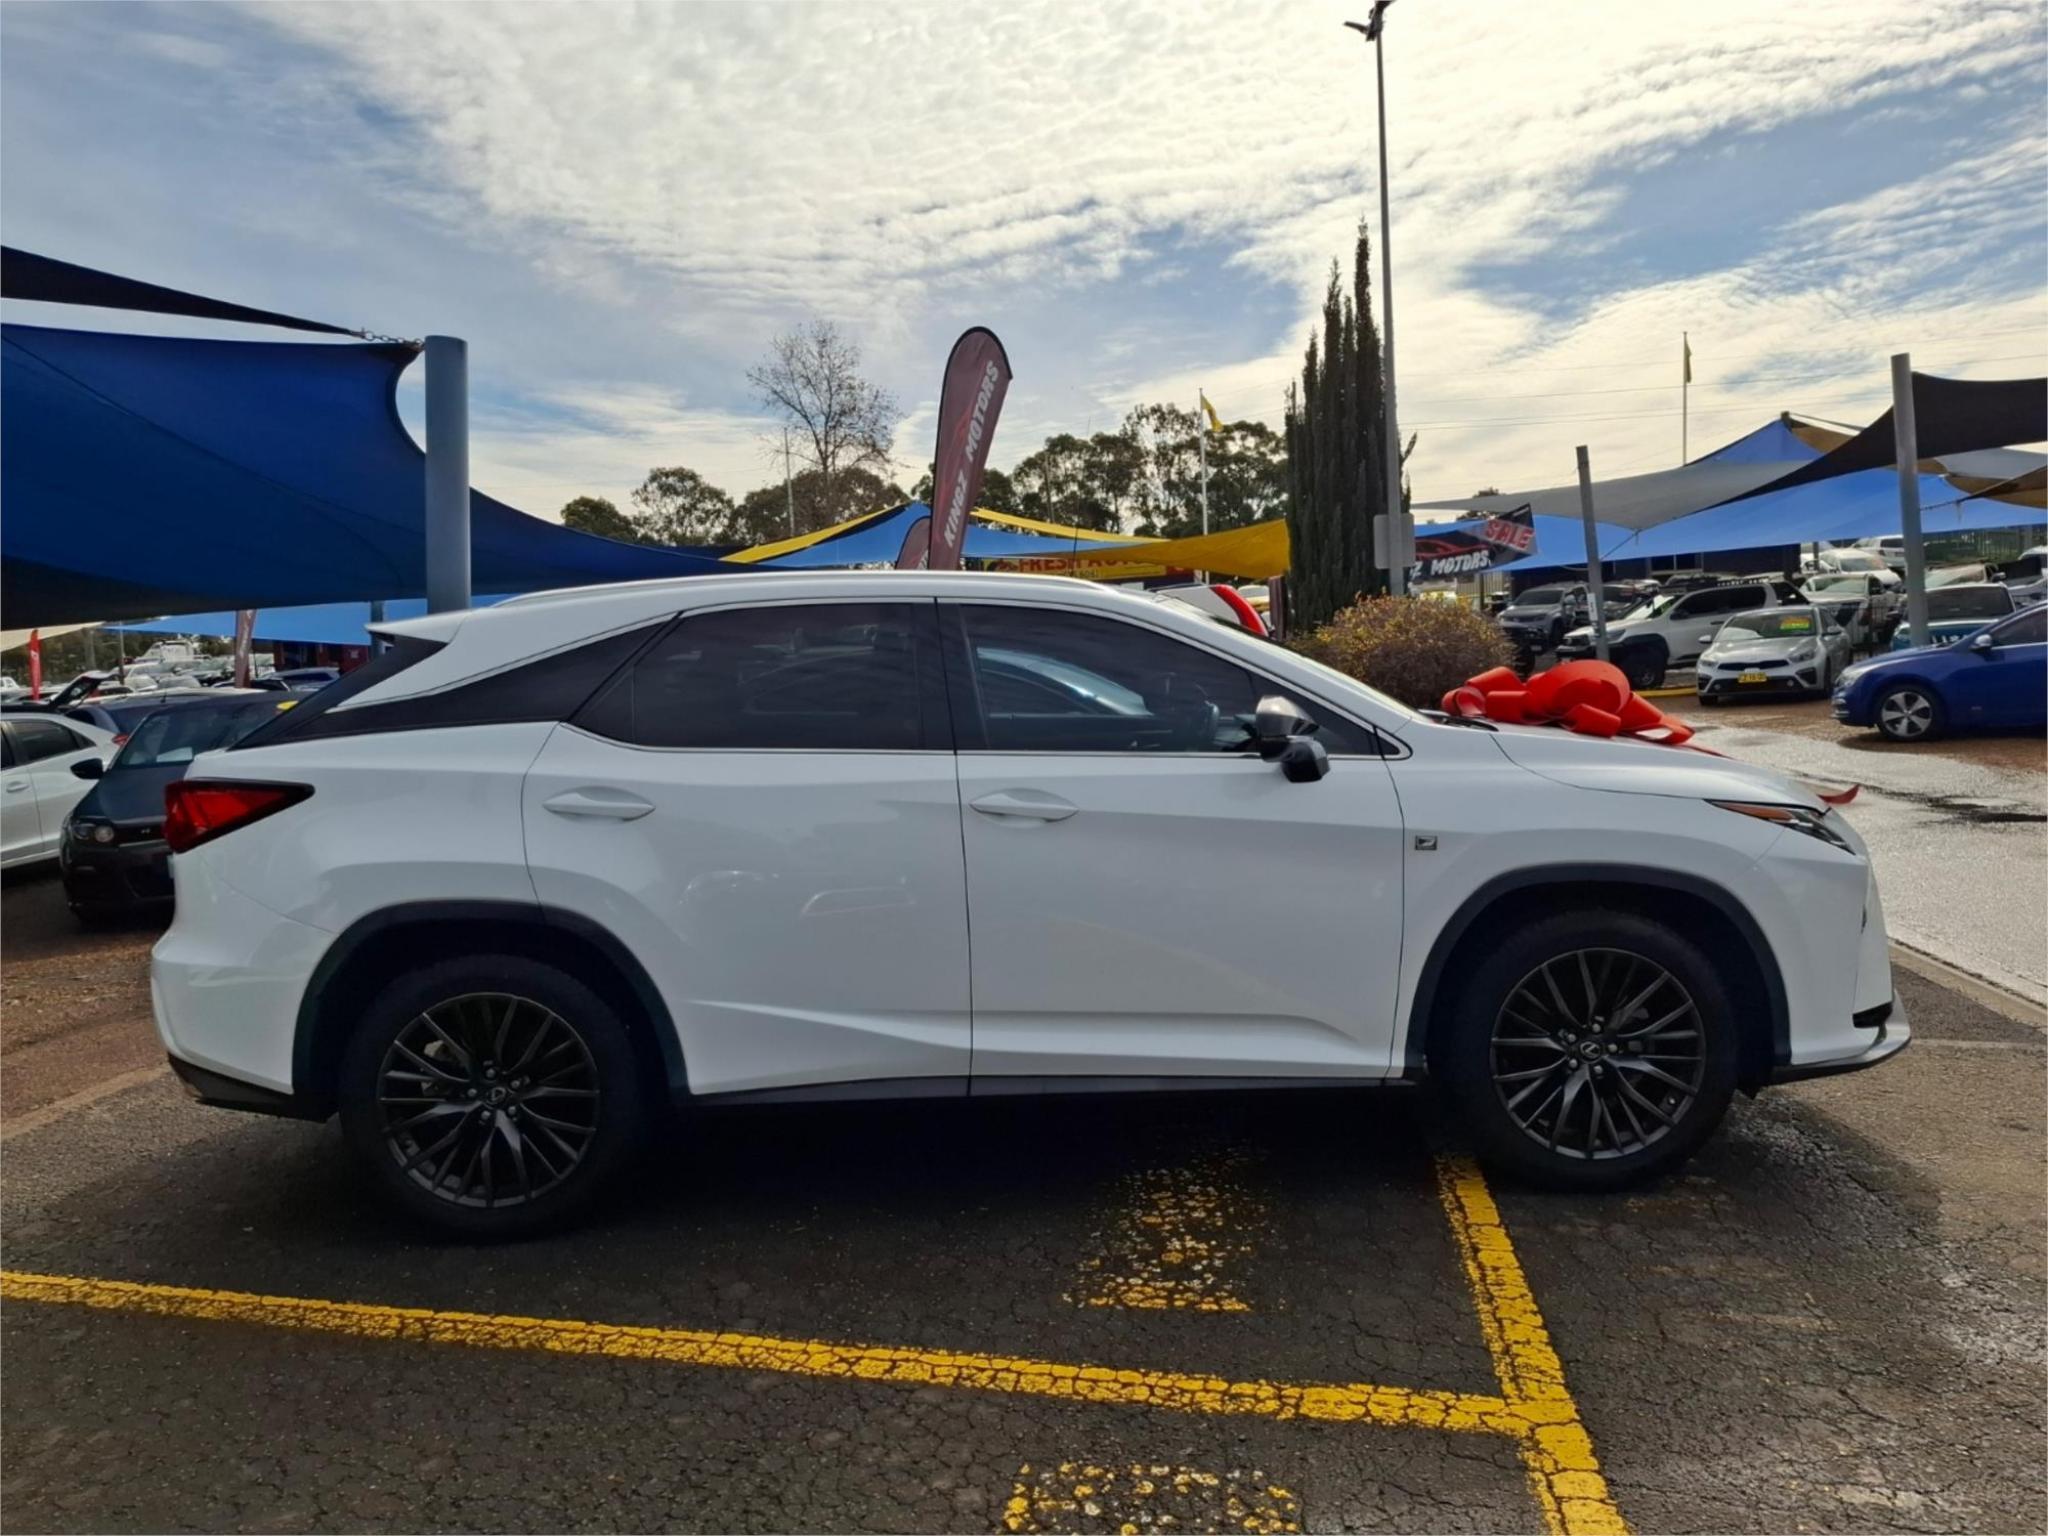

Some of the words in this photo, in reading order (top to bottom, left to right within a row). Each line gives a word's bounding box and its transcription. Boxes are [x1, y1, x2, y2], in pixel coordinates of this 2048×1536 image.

[944, 469, 968, 548] KINGZ
[965, 360, 999, 463] MOTORS
[1485, 519, 1535, 549] SALE
[1430, 549, 1489, 575] MOTORS
